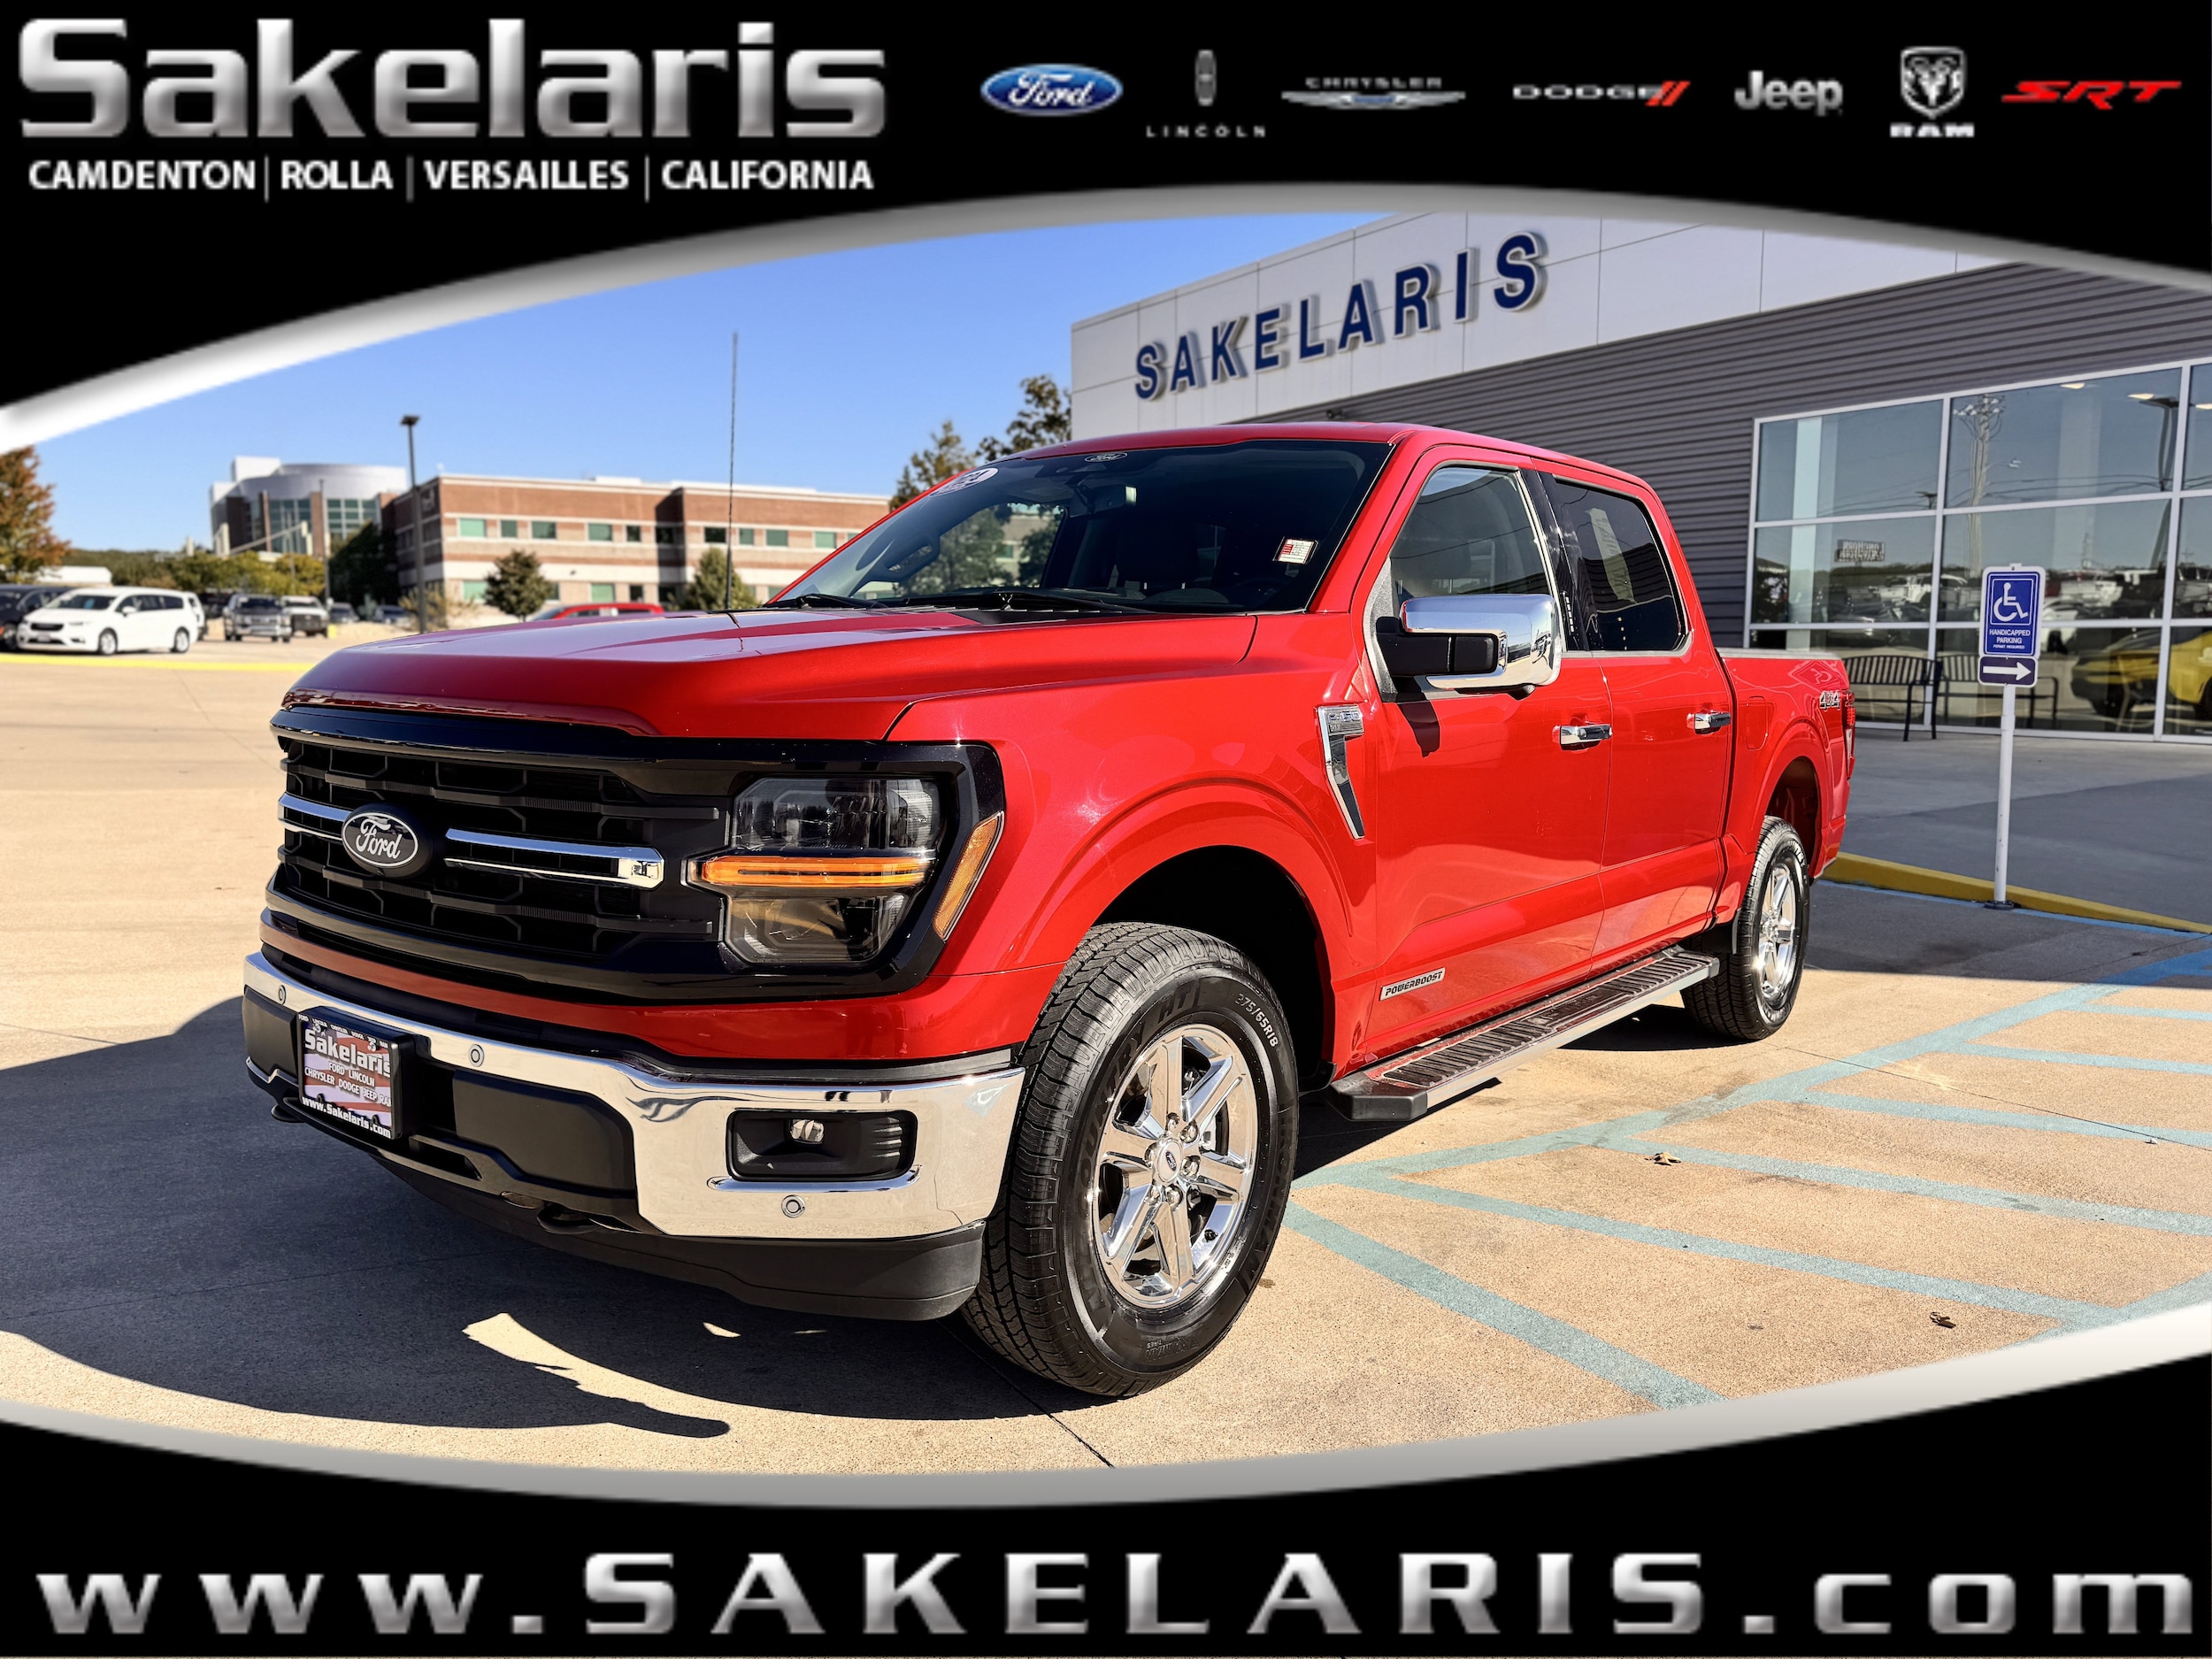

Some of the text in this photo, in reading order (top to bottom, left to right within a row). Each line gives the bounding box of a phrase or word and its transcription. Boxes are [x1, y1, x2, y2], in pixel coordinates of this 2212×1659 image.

[1134, 231, 1547, 401] SAKELARIS
[355, 818, 403, 859] Ford
[1385, 971, 1443, 996] POWERBOOST
[1234, 993, 1279, 1047] 275/65R18
[304, 1028, 391, 1079] Sakelaris
[328, 1061, 375, 1087] FORD LINCOLN
[304, 1066, 335, 1086] CHRYSLER
[338, 1079, 360, 1094] DODGE
[362, 1087, 378, 1102] JEEP
